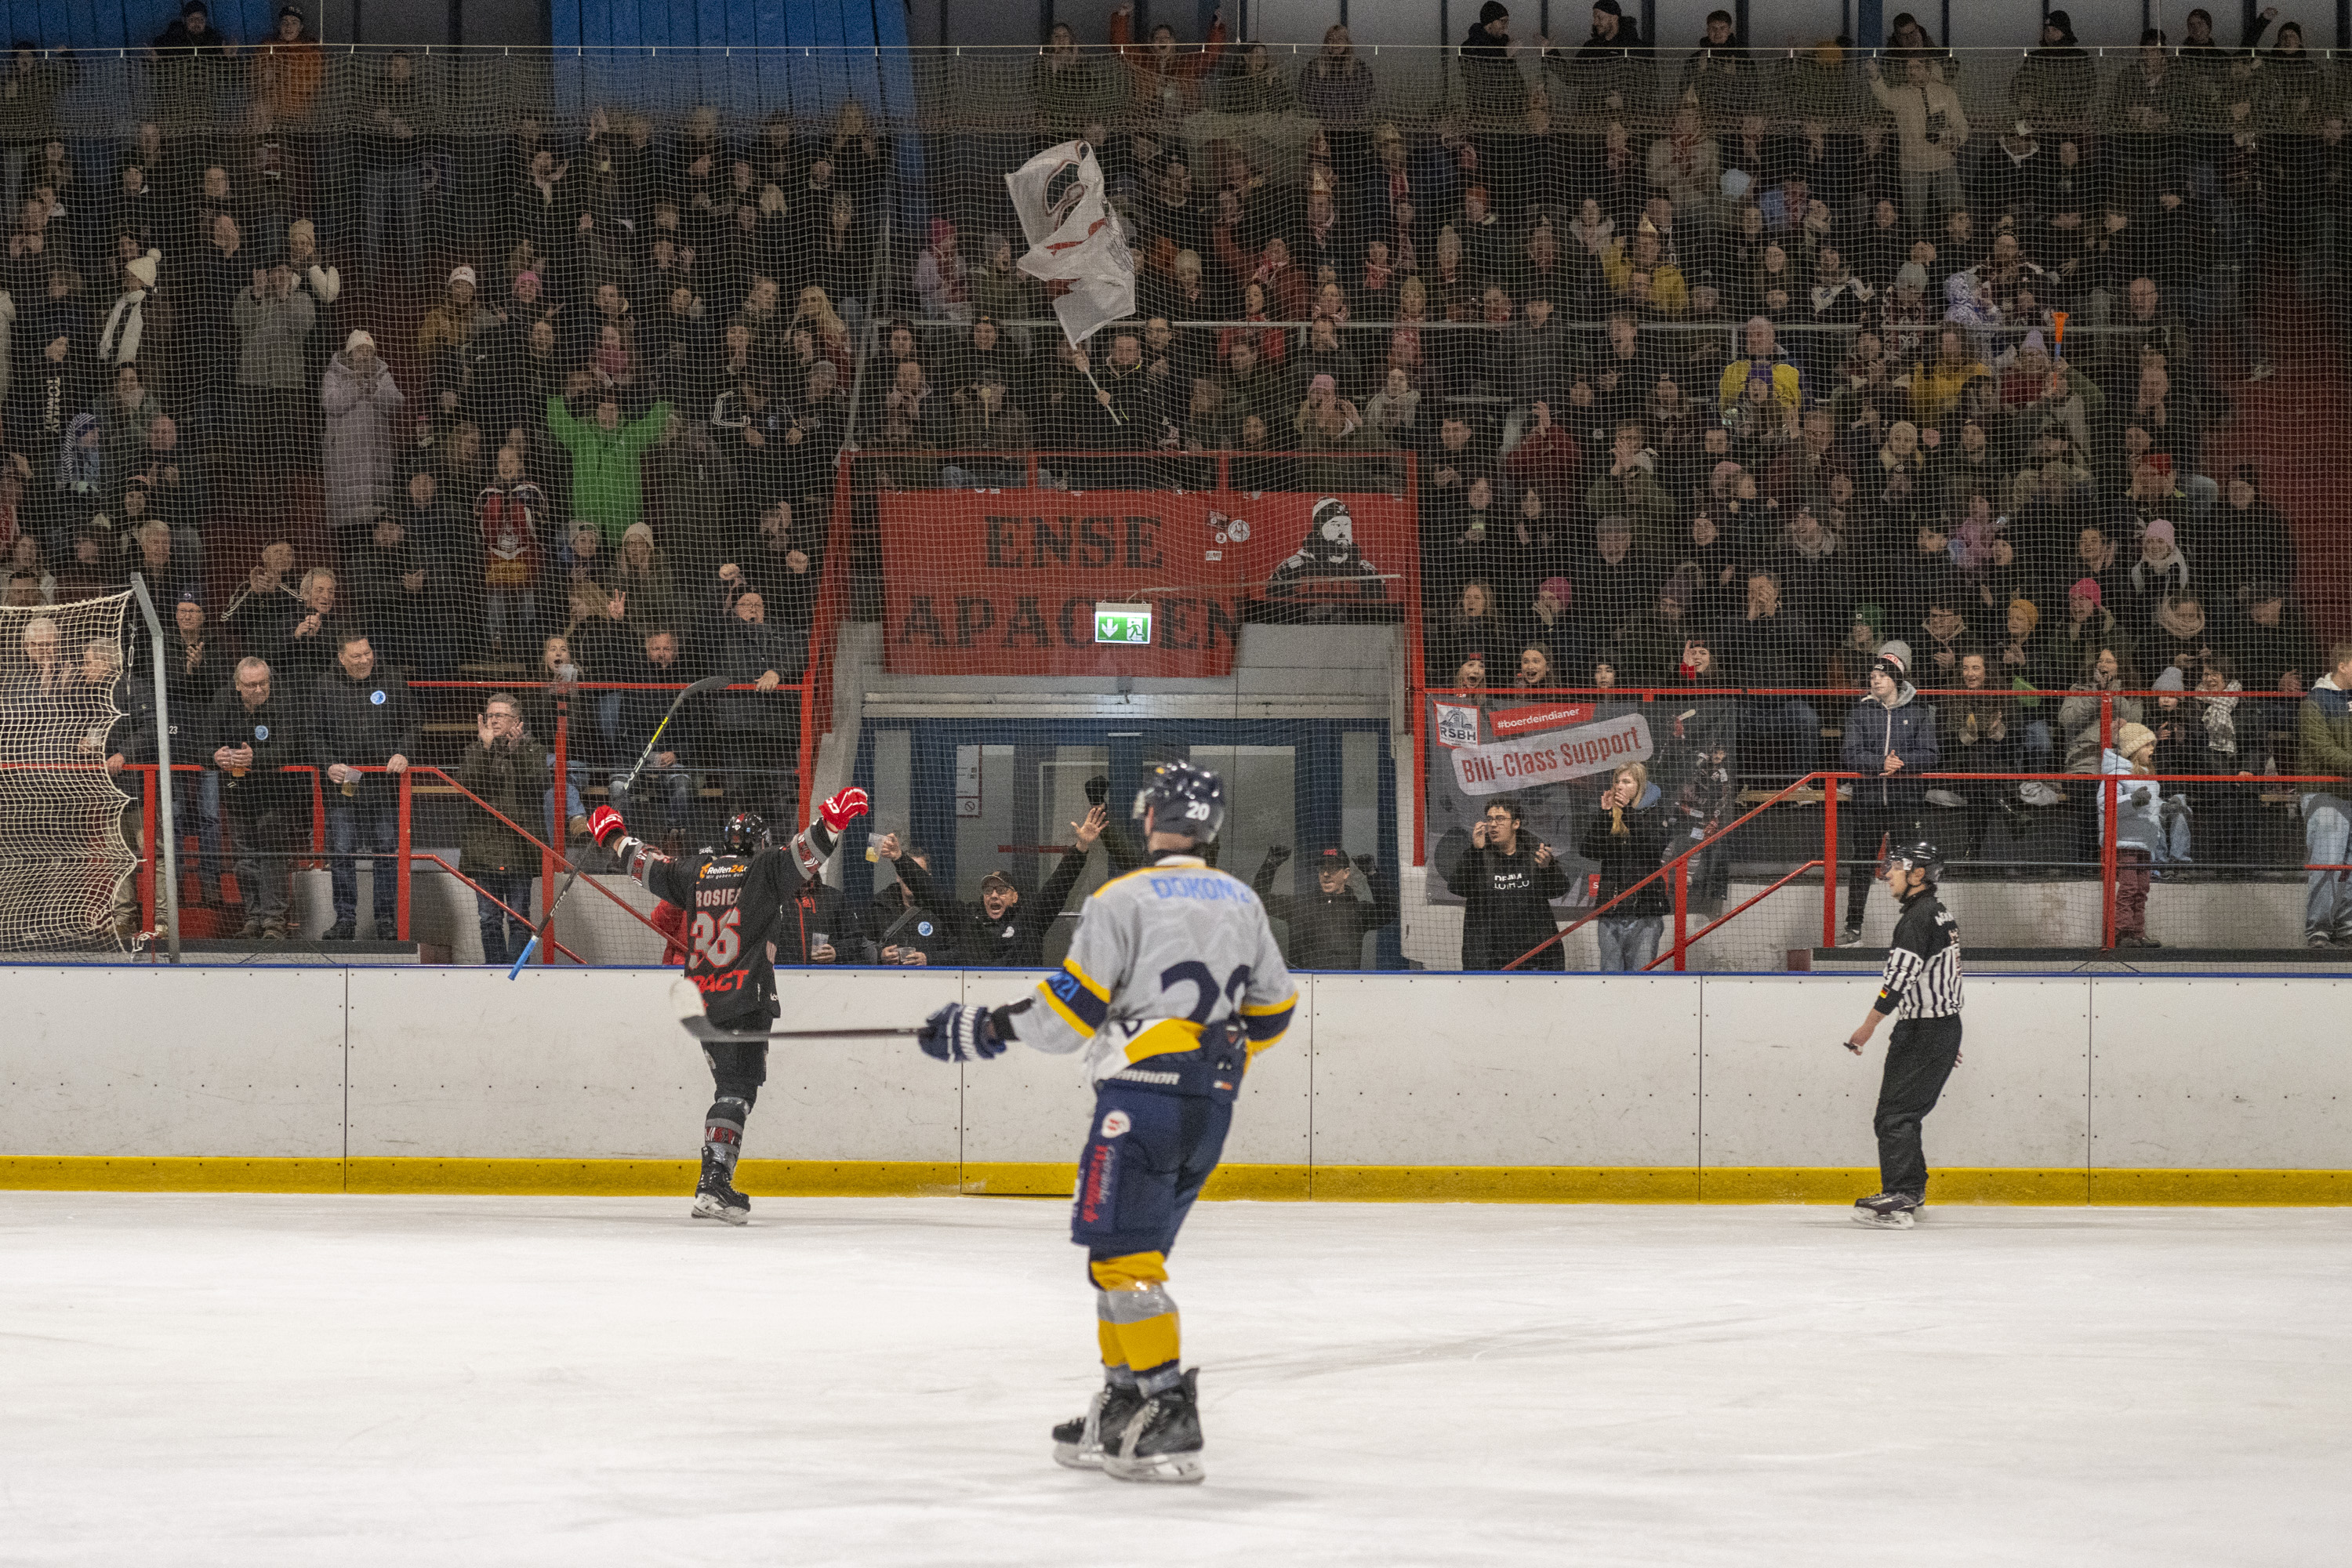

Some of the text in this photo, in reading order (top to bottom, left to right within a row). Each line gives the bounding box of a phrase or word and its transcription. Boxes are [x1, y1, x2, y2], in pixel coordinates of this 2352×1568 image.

[985, 516, 1163, 568] ENSE
[898, 595, 1245, 651] APACEN
[169, 725, 178, 735] 23
[1440, 727, 1476, 741] RSBH
[1497, 708, 1580, 728] #boerdeindianer
[1461, 726, 1642, 783] Bili-Class Support
[1185, 800, 1210, 821] 20
[688, 906, 741, 971] 36
